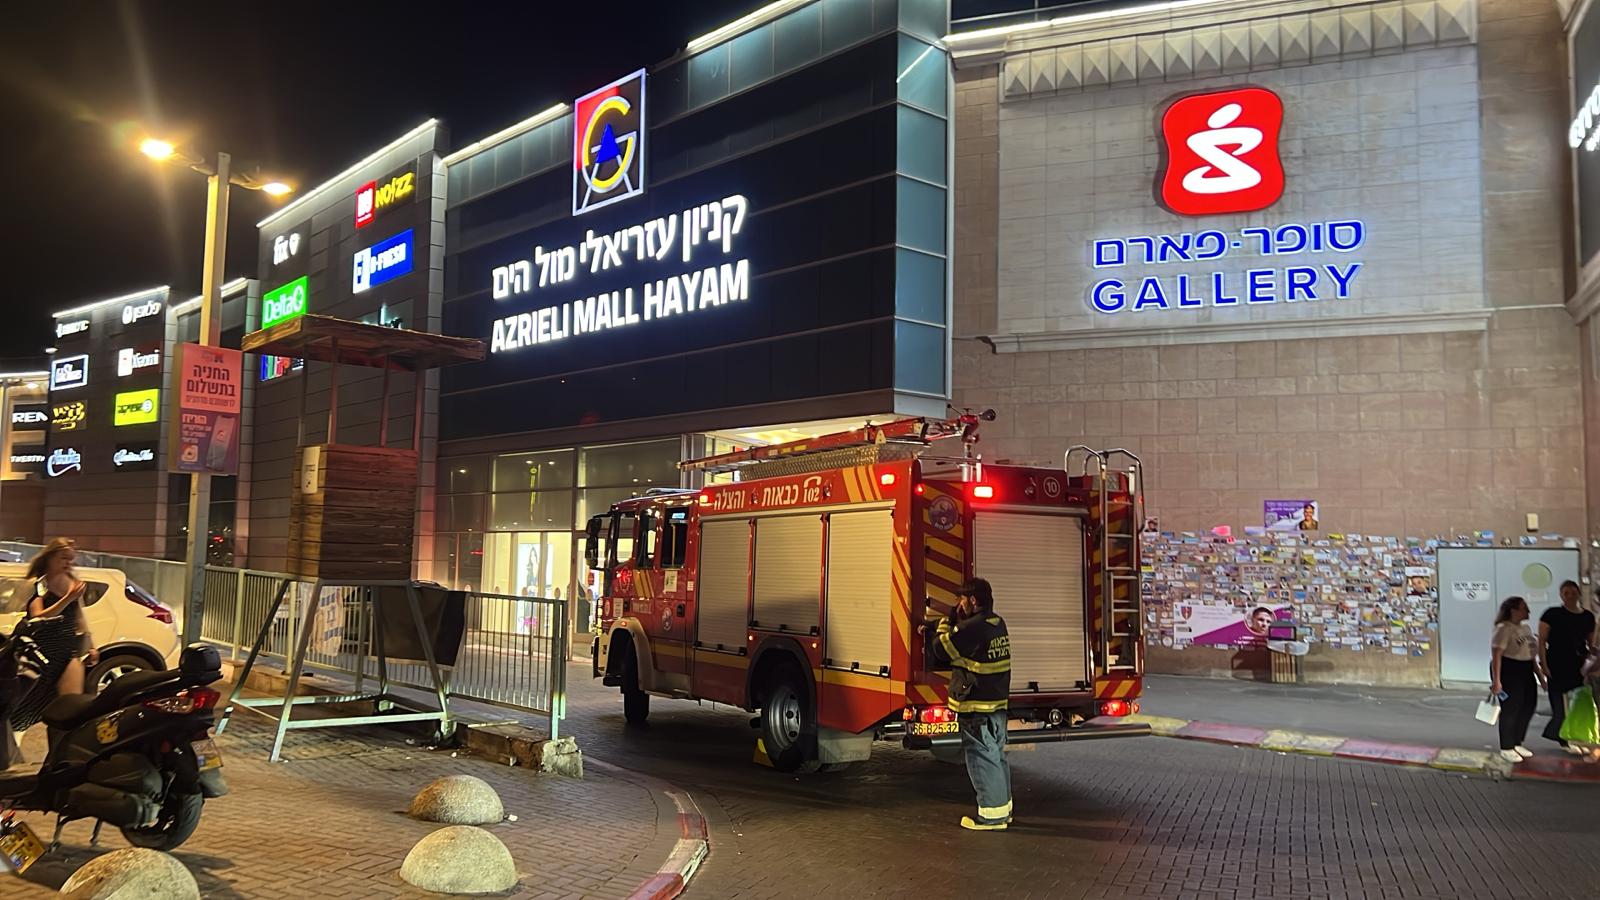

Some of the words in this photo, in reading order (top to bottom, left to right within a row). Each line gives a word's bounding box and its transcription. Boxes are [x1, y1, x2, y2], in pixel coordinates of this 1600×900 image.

[579, 213, 679, 273] עזריאלי
[682, 194, 750, 262] קניון
[1093, 219, 1366, 268] סופר-פארם
[491, 259, 531, 300] הים
[534, 245, 576, 288] מול
[490, 302, 569, 353] AZRIELI
[573, 287, 640, 336] MALL
[643, 258, 750, 321] HAYAM
[1091, 263, 1363, 314] GALLERY
[264, 293, 294, 324] Delta
[186, 378, 235, 397] בתשלום
[193, 364, 230, 381] החניה
[713, 488, 746, 511] והצלה
[761, 484, 799, 507] כבאות
[803, 486, 820, 503] 102
[1046, 481, 1058, 492] 10
